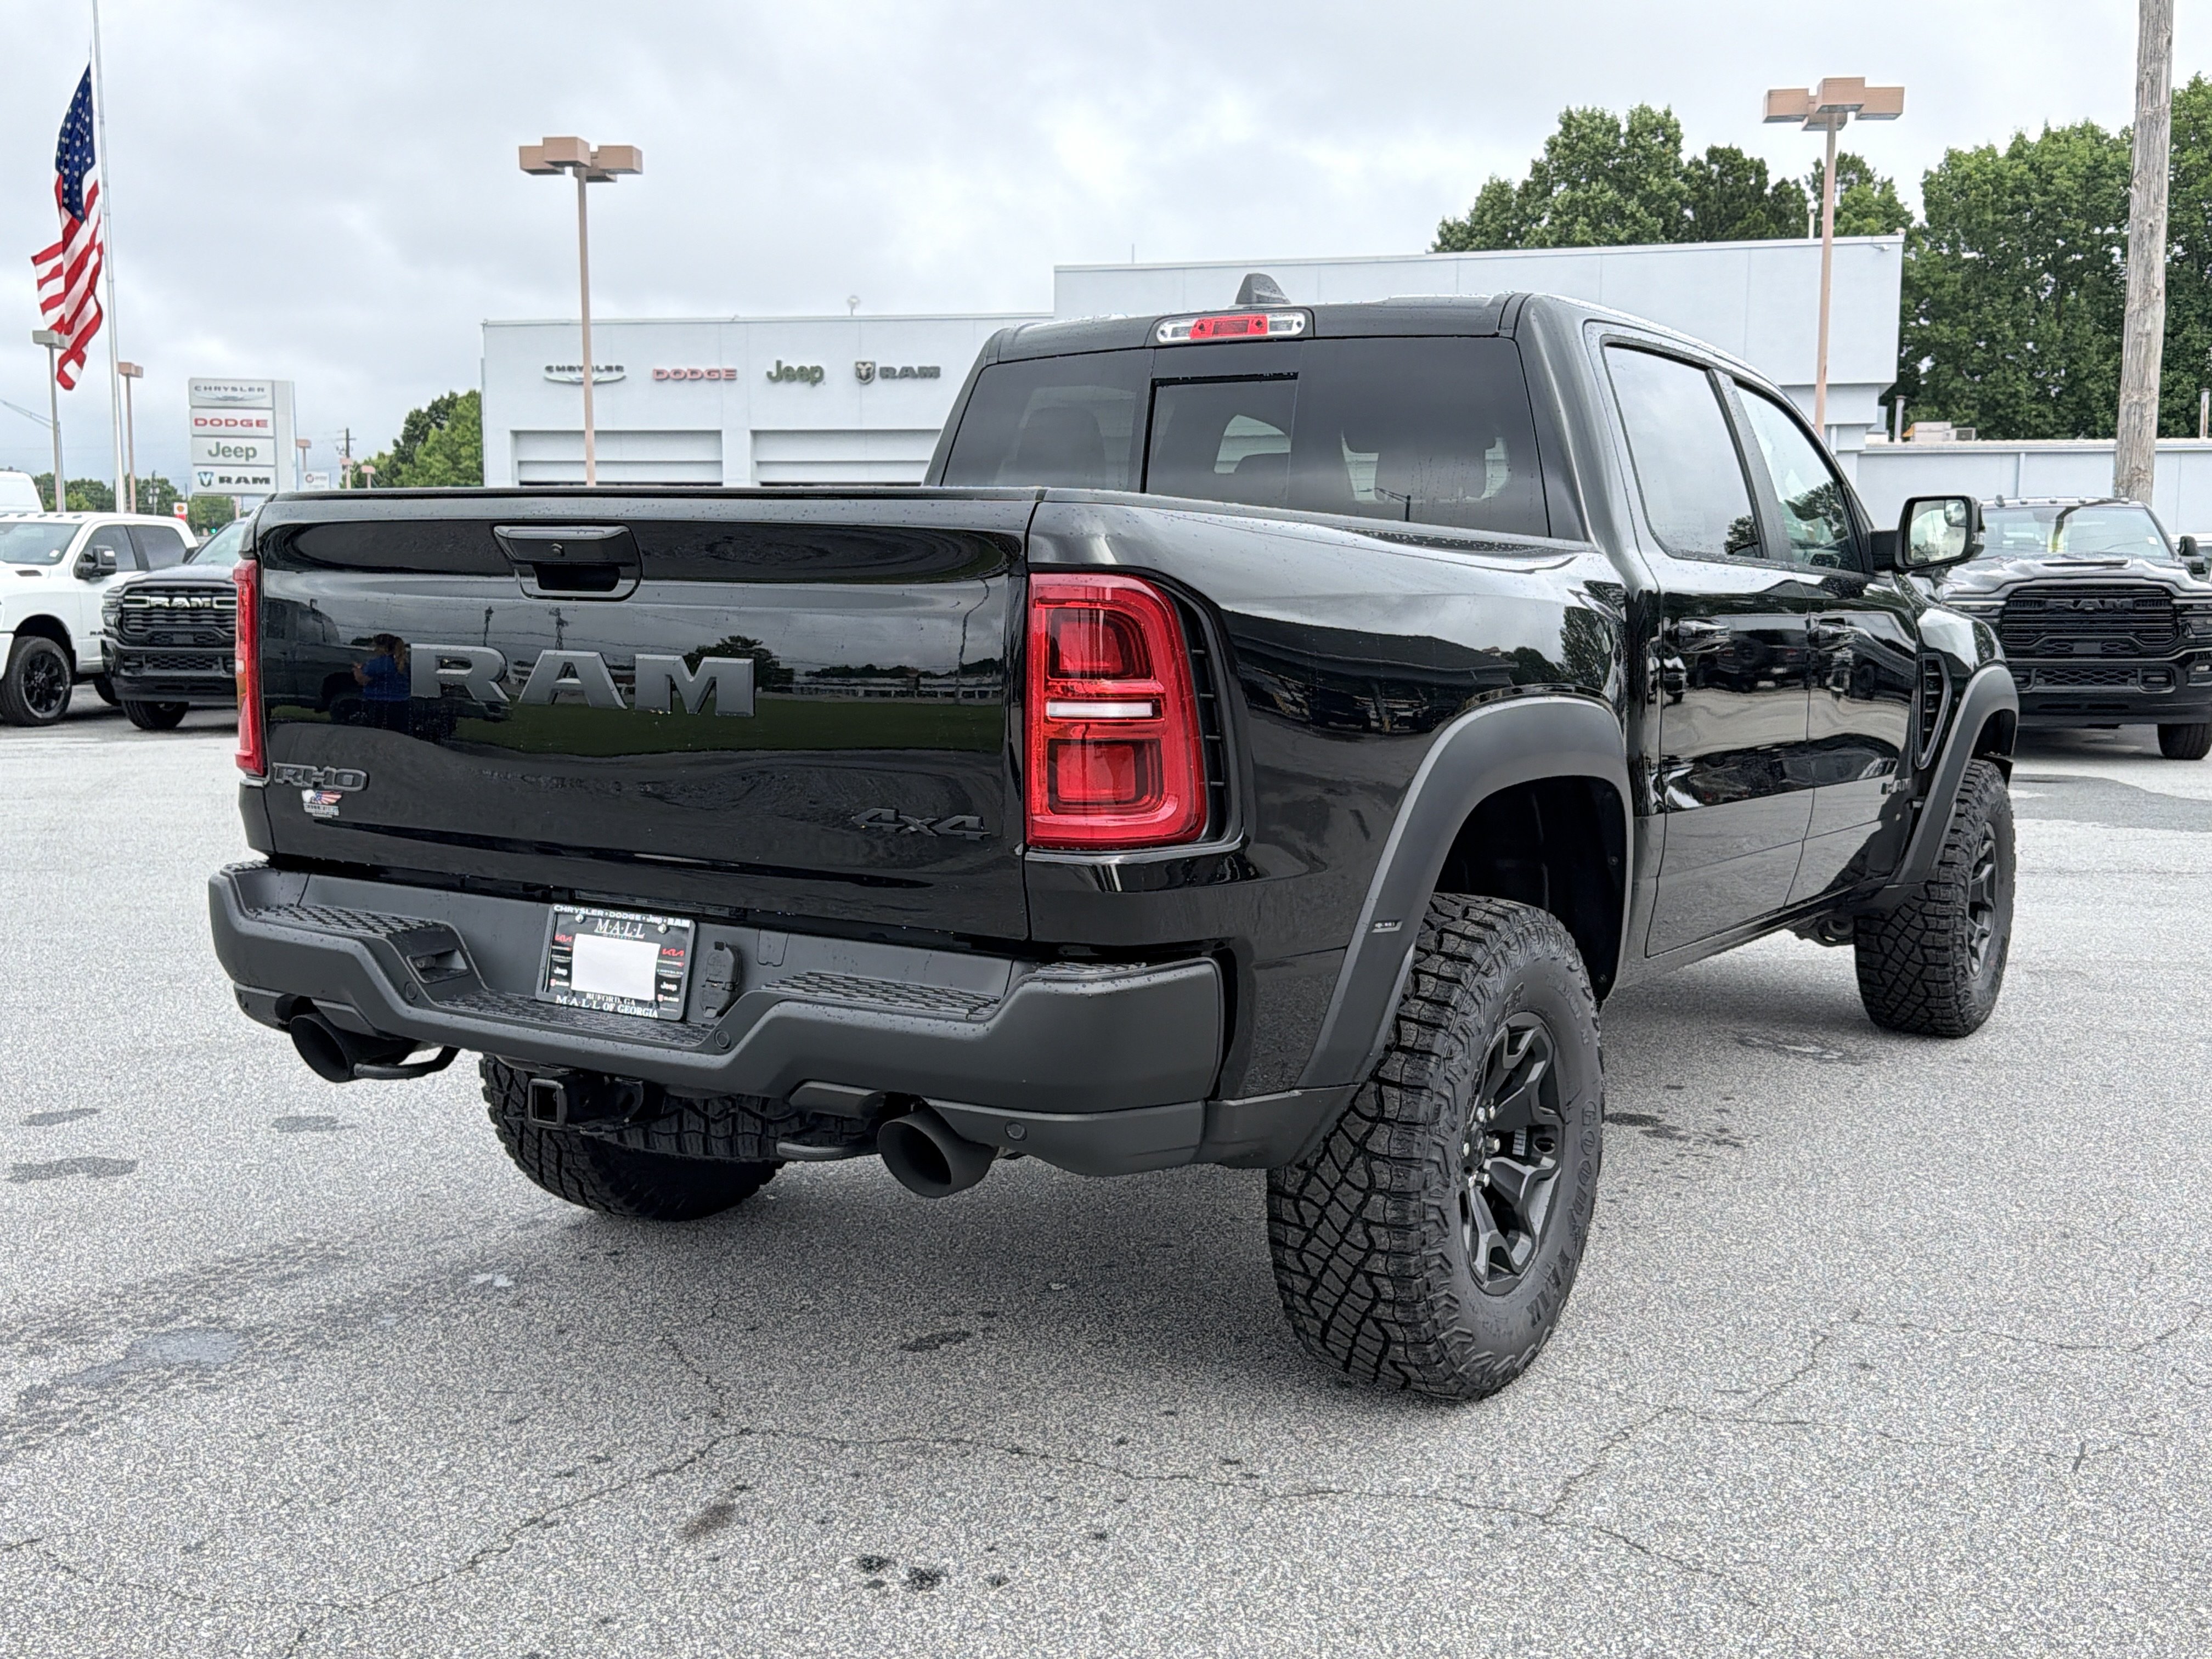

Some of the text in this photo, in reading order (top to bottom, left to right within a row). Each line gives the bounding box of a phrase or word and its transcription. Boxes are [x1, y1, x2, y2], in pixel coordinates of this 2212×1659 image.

[653, 368, 737, 381] DODGE
[766, 360, 823, 386] Jeep
[879, 366, 940, 379] RAM
[194, 417, 268, 428] DODGE
[208, 441, 257, 462] Jeep
[218, 476, 270, 485] RAM
[149, 596, 212, 608] RAM
[2046, 599, 2134, 610] RAM
[410, 643, 755, 716] RAM
[272, 762, 367, 791] RHO
[554, 905, 604, 917] CHRYSLER
[609, 912, 641, 921] DODGE
[667, 917, 691, 928] RAM
[602, 1002, 615, 1012] OF
[617, 1003, 658, 1018] GEORGIA
